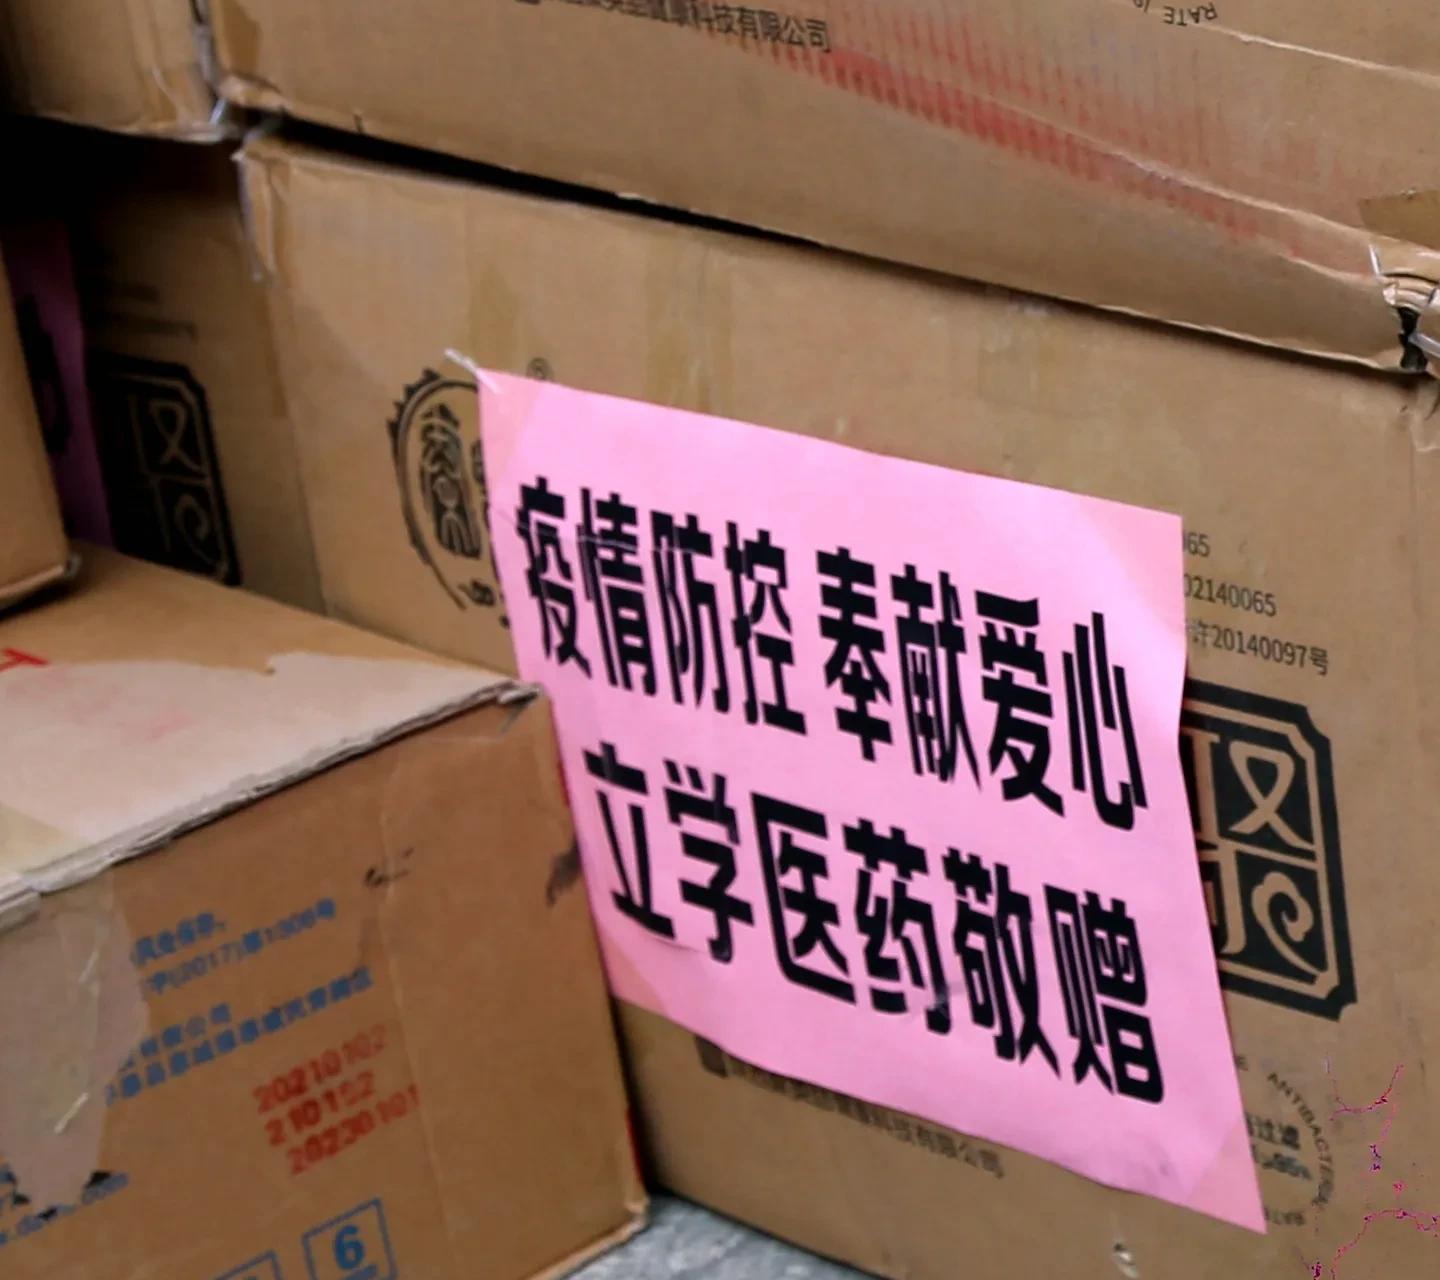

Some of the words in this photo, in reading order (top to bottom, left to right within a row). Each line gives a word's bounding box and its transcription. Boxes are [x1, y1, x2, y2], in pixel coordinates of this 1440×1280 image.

[1163, 2, 1218, 27] RATE
[516, 476, 807, 736] 疫情防控
[815, 546, 1149, 831] 奉献爱心
[585, 741, 1163, 1103] 立学医药敬赠
[333, 1225, 365, 1271] 6
